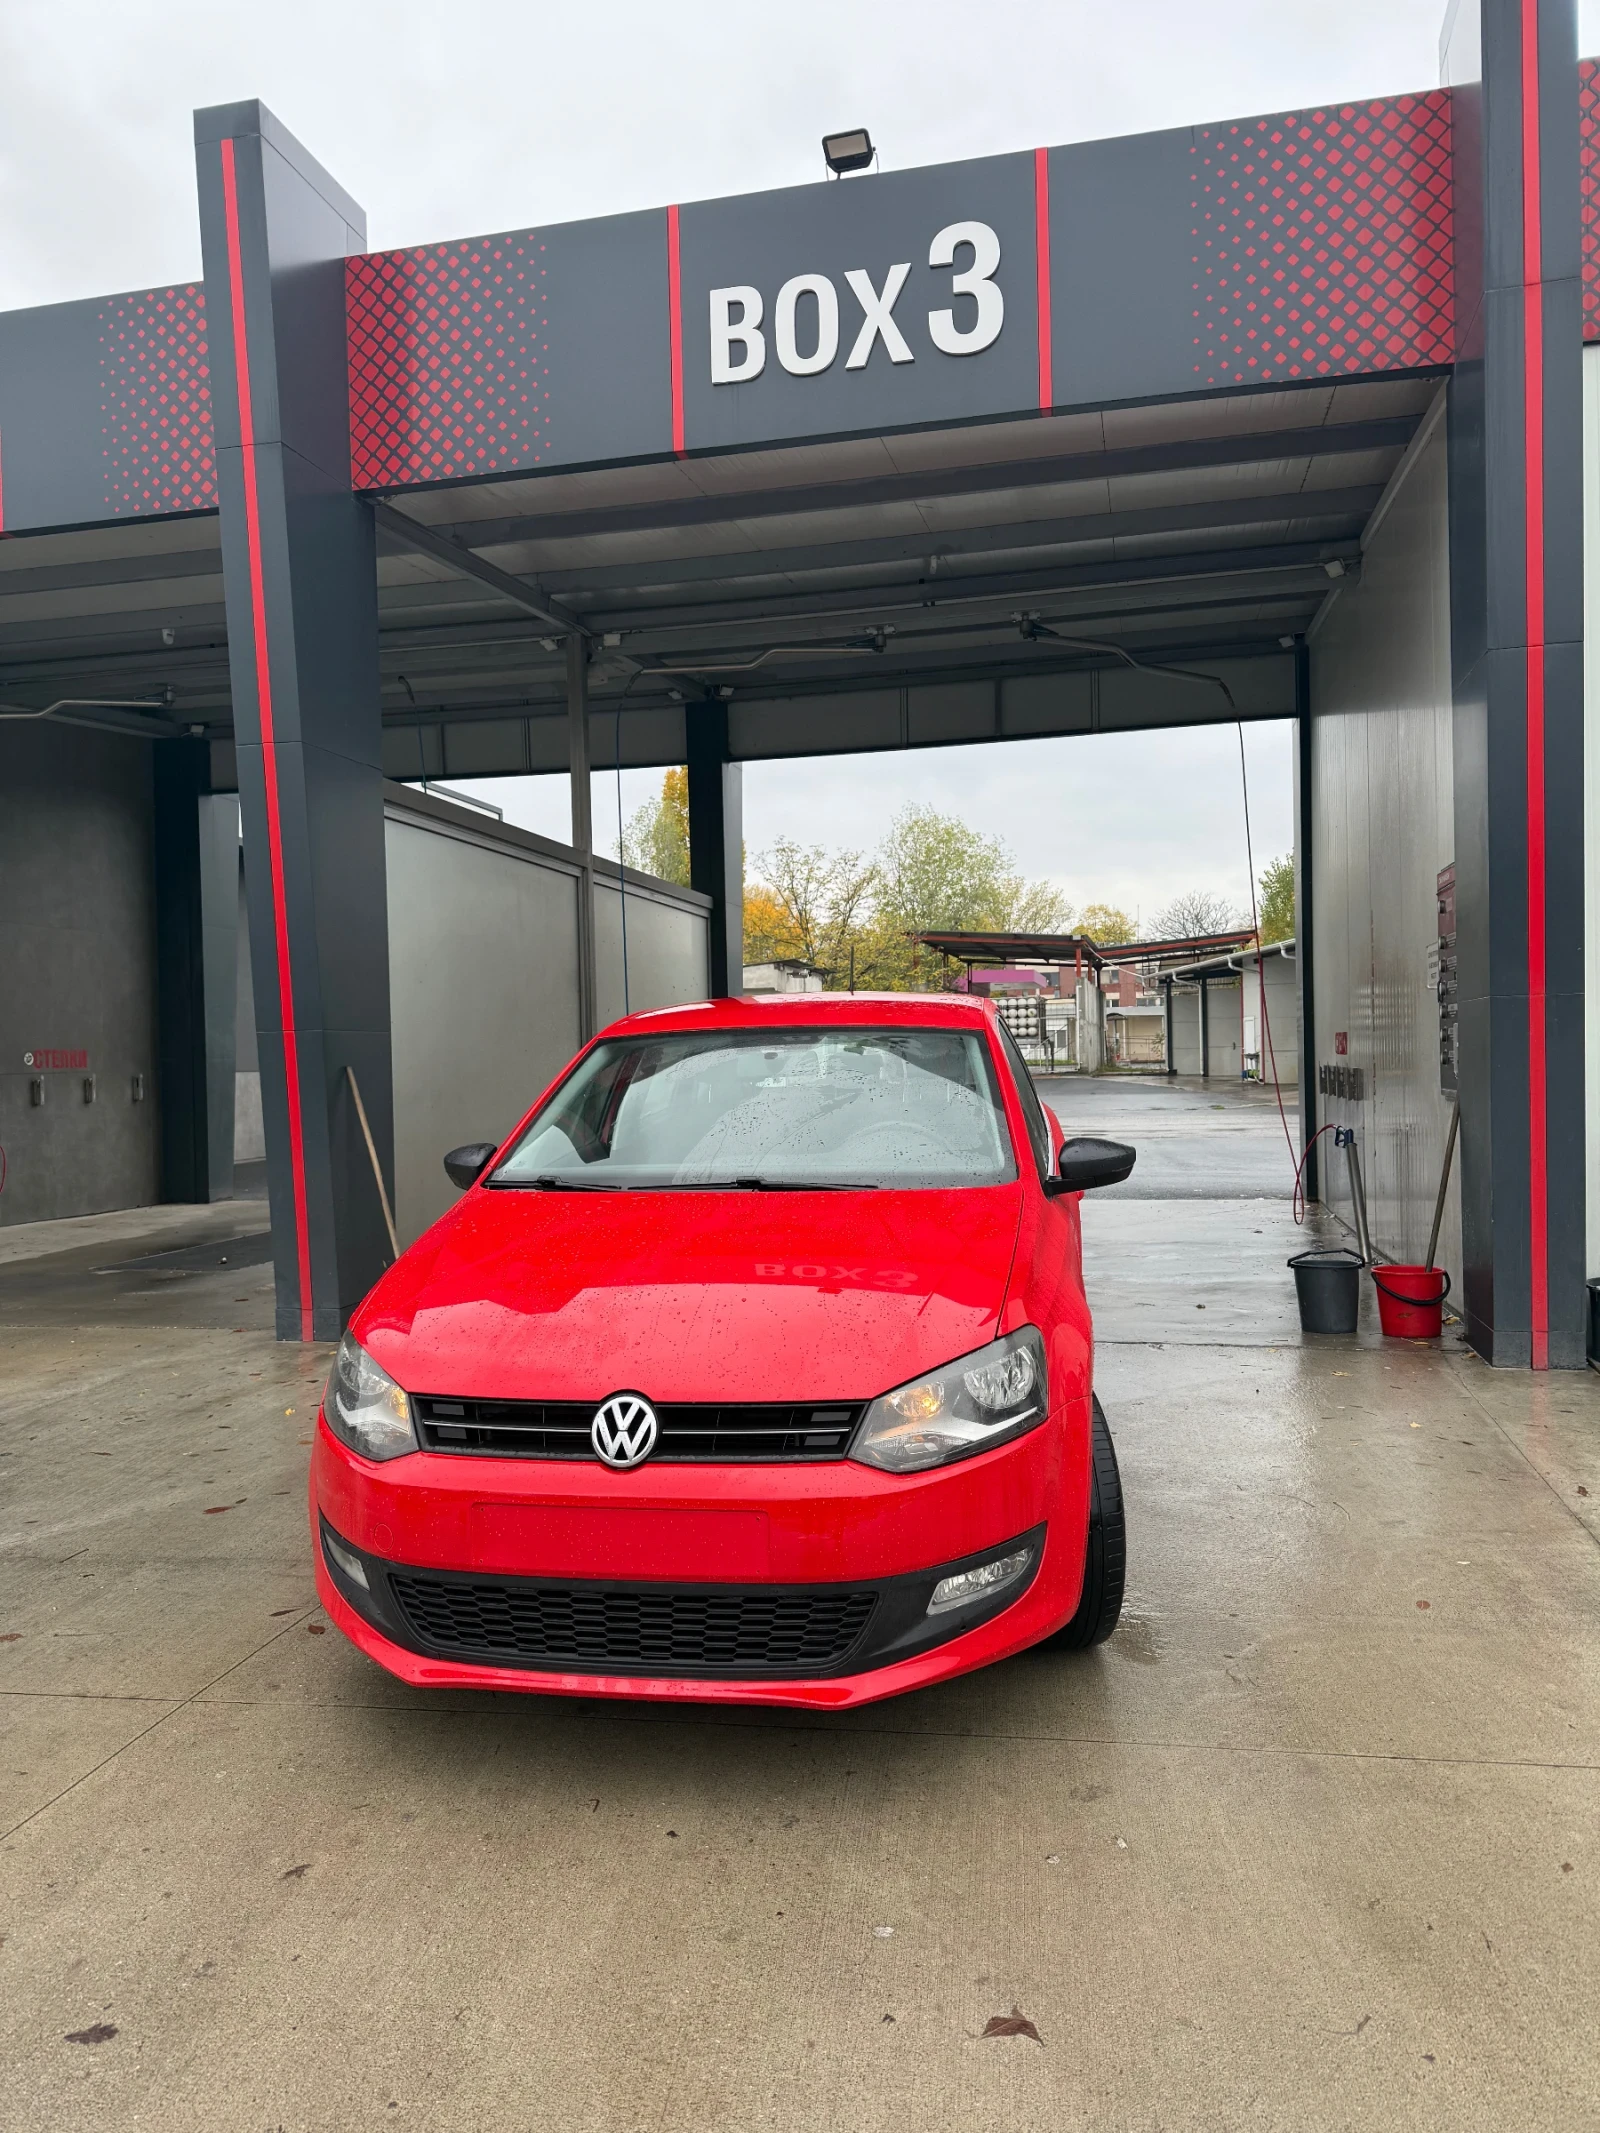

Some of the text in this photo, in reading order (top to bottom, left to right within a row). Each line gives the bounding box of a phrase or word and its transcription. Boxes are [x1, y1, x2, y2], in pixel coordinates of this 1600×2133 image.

[709, 221, 1005, 386] BOX 3
[594, 1398, 655, 1464] VW
